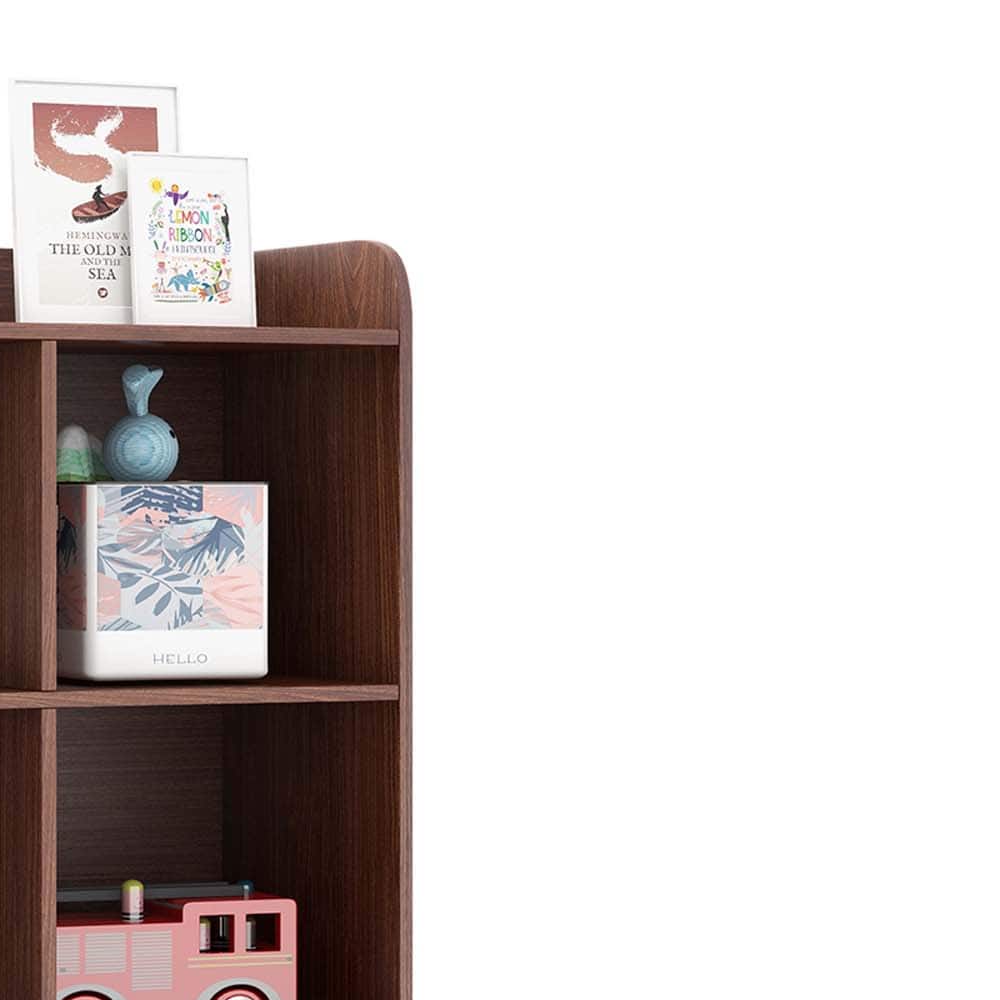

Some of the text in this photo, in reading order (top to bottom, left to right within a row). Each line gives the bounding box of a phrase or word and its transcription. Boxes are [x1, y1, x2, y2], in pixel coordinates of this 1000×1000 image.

[168, 209, 209, 224] LEMON
[168, 227, 212, 241] RIBBON
[49, 243, 80, 255] THE
[84, 244, 116, 255] OLD
[80, 258, 102, 266] AND
[88, 267, 117, 280] SEA
[153, 653, 208, 664] HELLO
